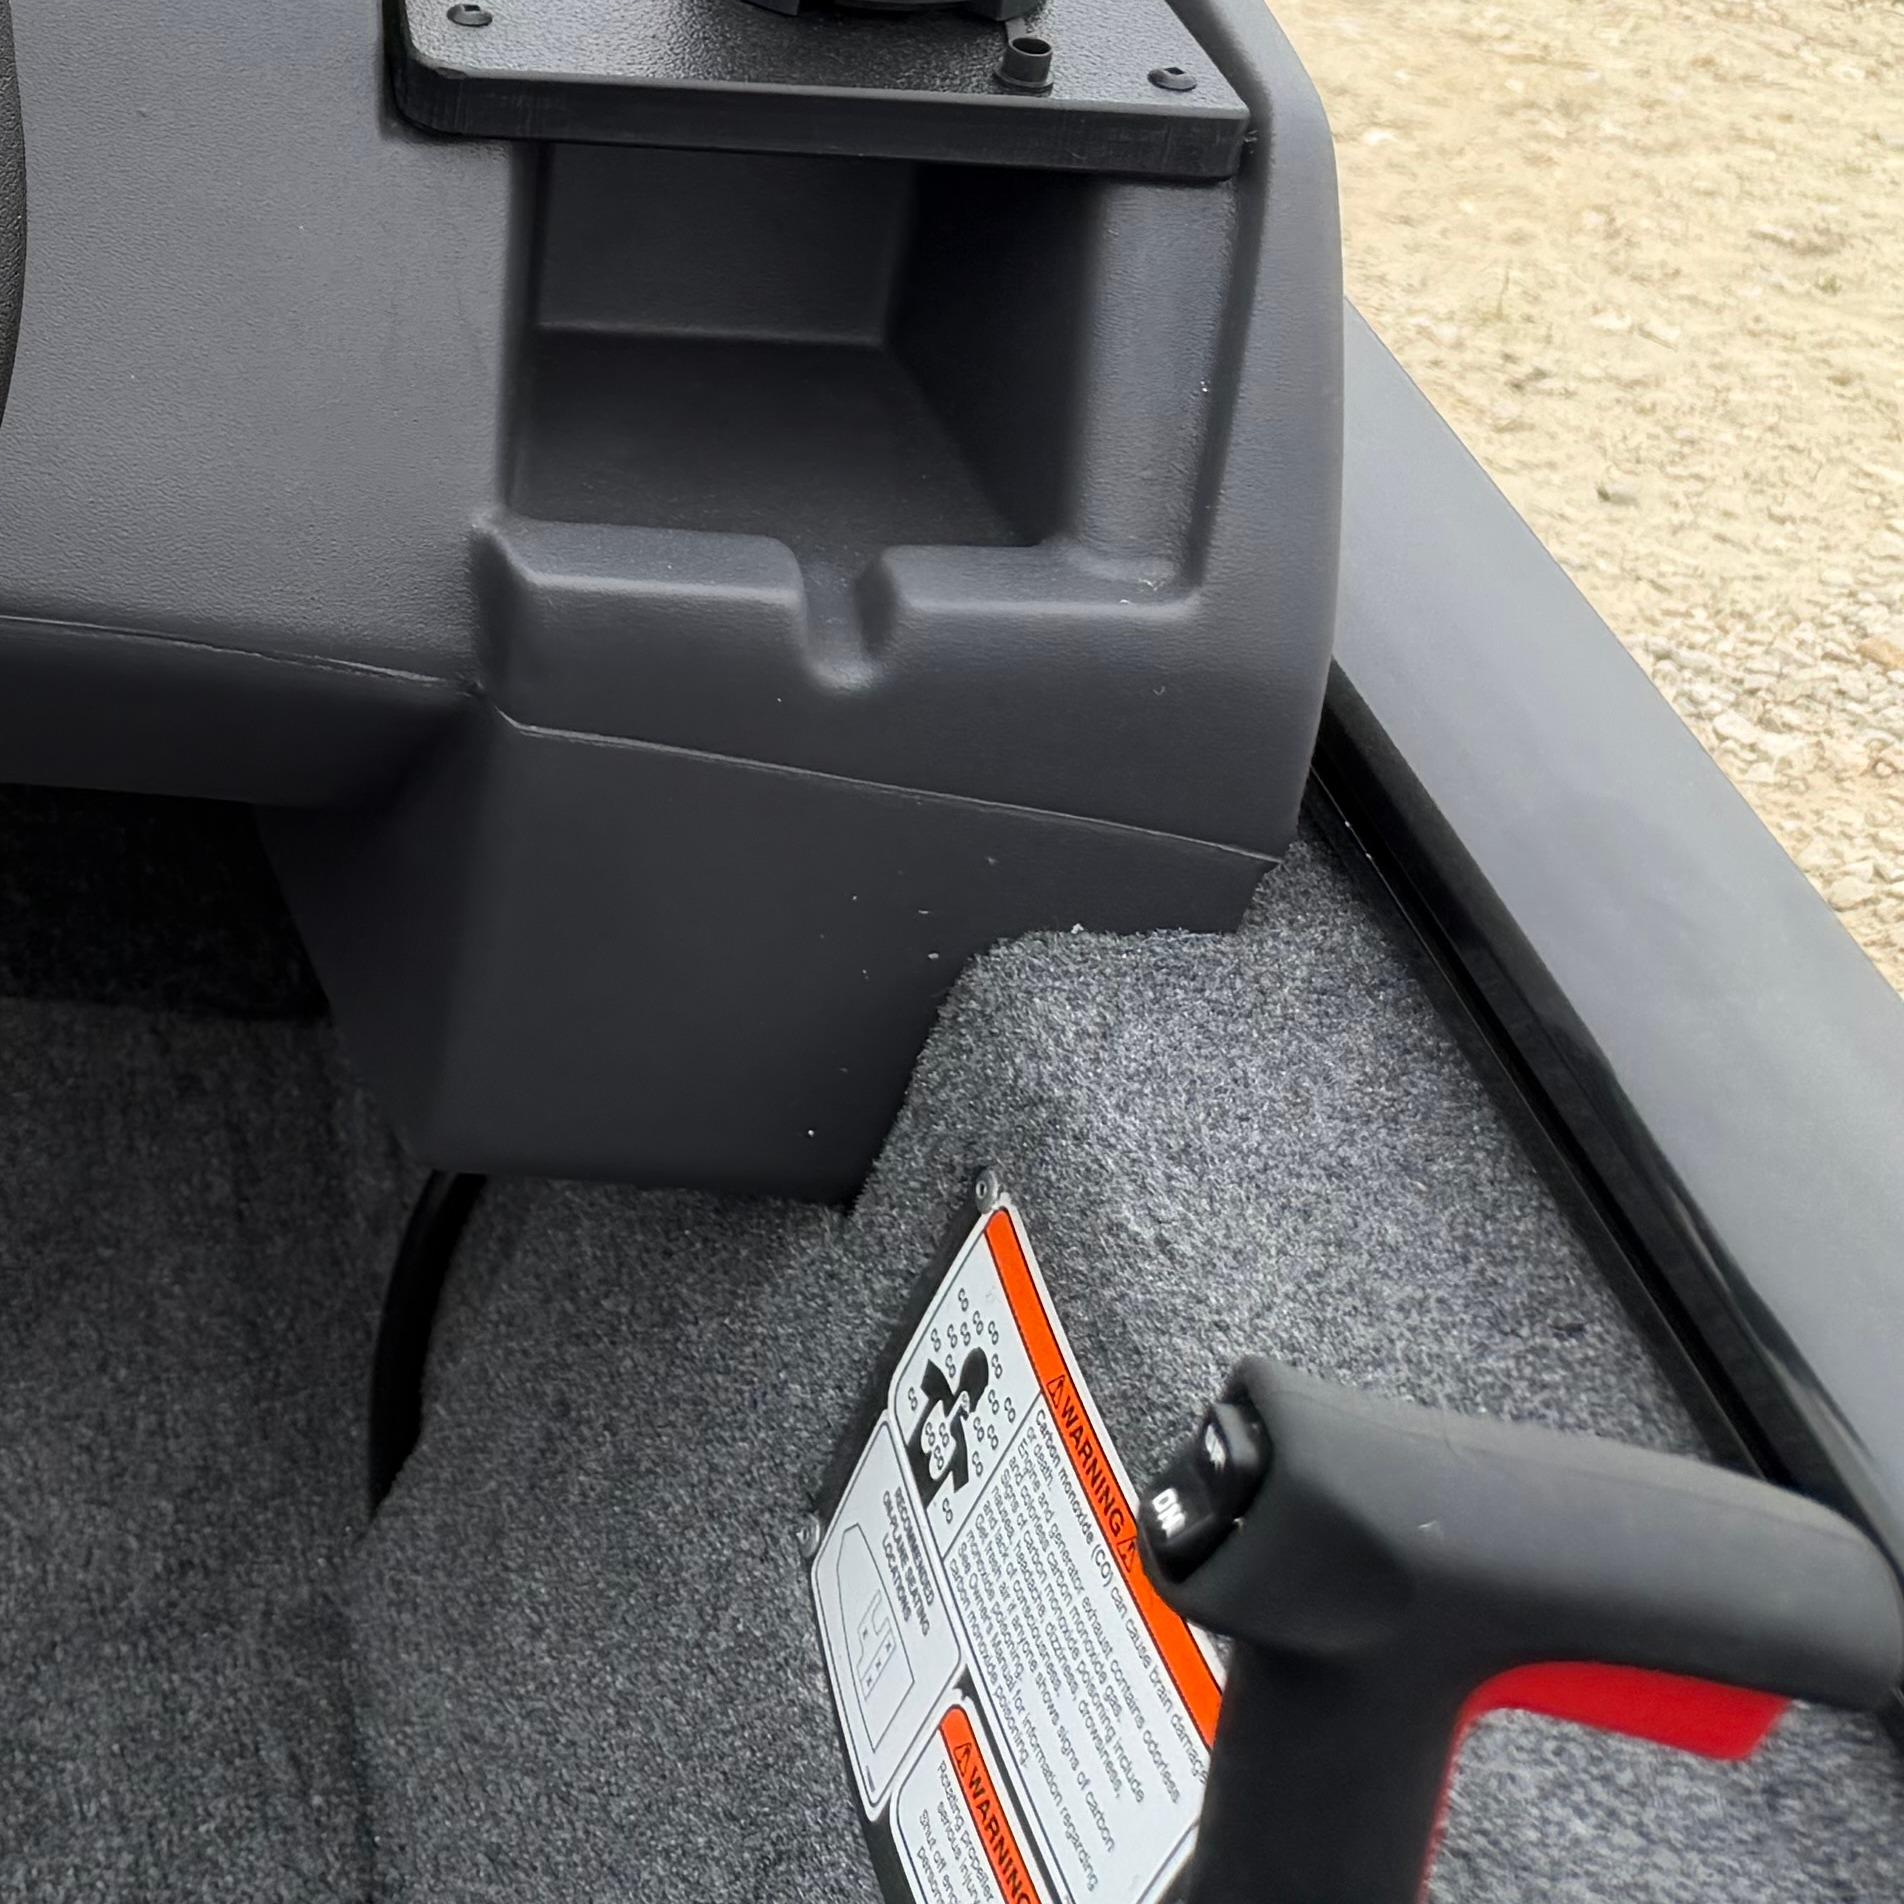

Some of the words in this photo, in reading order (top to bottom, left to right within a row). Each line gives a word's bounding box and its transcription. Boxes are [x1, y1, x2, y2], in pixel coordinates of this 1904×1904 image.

[957, 1287, 969, 1312] CO
[946, 1323, 958, 1349] CO
[960, 1322, 971, 1347] CO
[972, 1310, 984, 1336] CO
[987, 1320, 999, 1346] CO
[930, 1328, 941, 1353] CO
[945, 1353, 957, 1379] CO
[991, 1353, 1003, 1380] CO
[907, 1386, 918, 1412] CO
[987, 1389, 1000, 1416] CO
[1004, 1396, 1016, 1424] CO
[925, 1421, 936, 1447] CO
[938, 1422, 950, 1448] CO
[973, 1416, 985, 1443] CO
[987, 1424, 999, 1451] CO
[934, 1445, 945, 1471] CO
[971, 1450, 984, 1477] CO
[1026, 1425, 1036, 1447] or
[1033, 1439, 1055, 1491] death.
[1059, 1394, 1125, 1538] WARNING
[942, 1497, 953, 1525] CO
[1034, 1407, 1061, 1468] Carbon
[1058, 1465, 1094, 1545] monoxide
[1090, 1540, 1114, 1590] (CO)
[1110, 1584, 1126, 1619] can
[1124, 1617, 1151, 1671] cause
[1148, 1664, 1172, 1714] brain
[982, 1499, 998, 1531] and
[993, 1525, 1011, 1563] lack
[1006, 1559, 1017, 1581] of
[1012, 1577, 1061, 1697] consciousness.
[1008, 1454, 1025, 1487] and
[1020, 1483, 1050, 1553] colorless
[1046, 1548, 1072, 1607] carbon
[1069, 1603, 1107, 1686] monoxide
[1102, 1684, 1121, 1723] gas.
[965, 1527, 995, 1603] monoxide
[989, 1599, 1023, 1680] poisoning.
[1017, 1436, 1040, 1494] Engine
[1037, 1490, 1054, 1524] and
[1047, 1520, 1084, 1596] generator
[1082, 1593, 1114, 1660] exhaust
[1109, 1657, 1144, 1730] contains
[1142, 1727, 1179, 1804] odorless
[991, 1483, 1014, 1548] nausea,
[1013, 1538, 1045, 1626] headache,
[1044, 1617, 1078, 1704] dizziness,
[1077, 1695, 1121, 1802] drowsiness,
[999, 1466, 1018, 1514] Signs
[1016, 1510, 1027, 1532] of
[1022, 1528, 1047, 1584] carbon
[1044, 1581, 1080, 1661] monoxide
[1075, 1658, 1115, 1746] poisoning
[1113, 1736, 1144, 1805] include
[948, 1556, 970, 1611] carbon
[967, 1608, 998, 1685] monoxide
[993, 1682, 1029, 1768] poisoning.
[973, 1511, 989, 1545] Get
[984, 1538, 1004, 1581] fresh
[999, 1578, 1010, 1603] air
[1007, 1597, 1016, 1616] if
[1012, 1613, 1037, 1673] anyone
[1035, 1671, 1059, 1727] shows
[1056, 1723, 1079, 1772] signs
[1076, 1769, 1089, 1792] of
[1085, 1789, 1114, 1854] carbon
[957, 1540, 971, 1576] See
[967, 1569, 993, 1636] Owner's
[990, 1629, 1017, 1693] Manual
[1012, 1686, 1025, 1717] for
[1022, 1710, 1062, 1808] information
[1059, 1804, 1098, 1894] regarding
[932, 1850, 945, 1875] off
[960, 1828, 993, 1904] propeller
